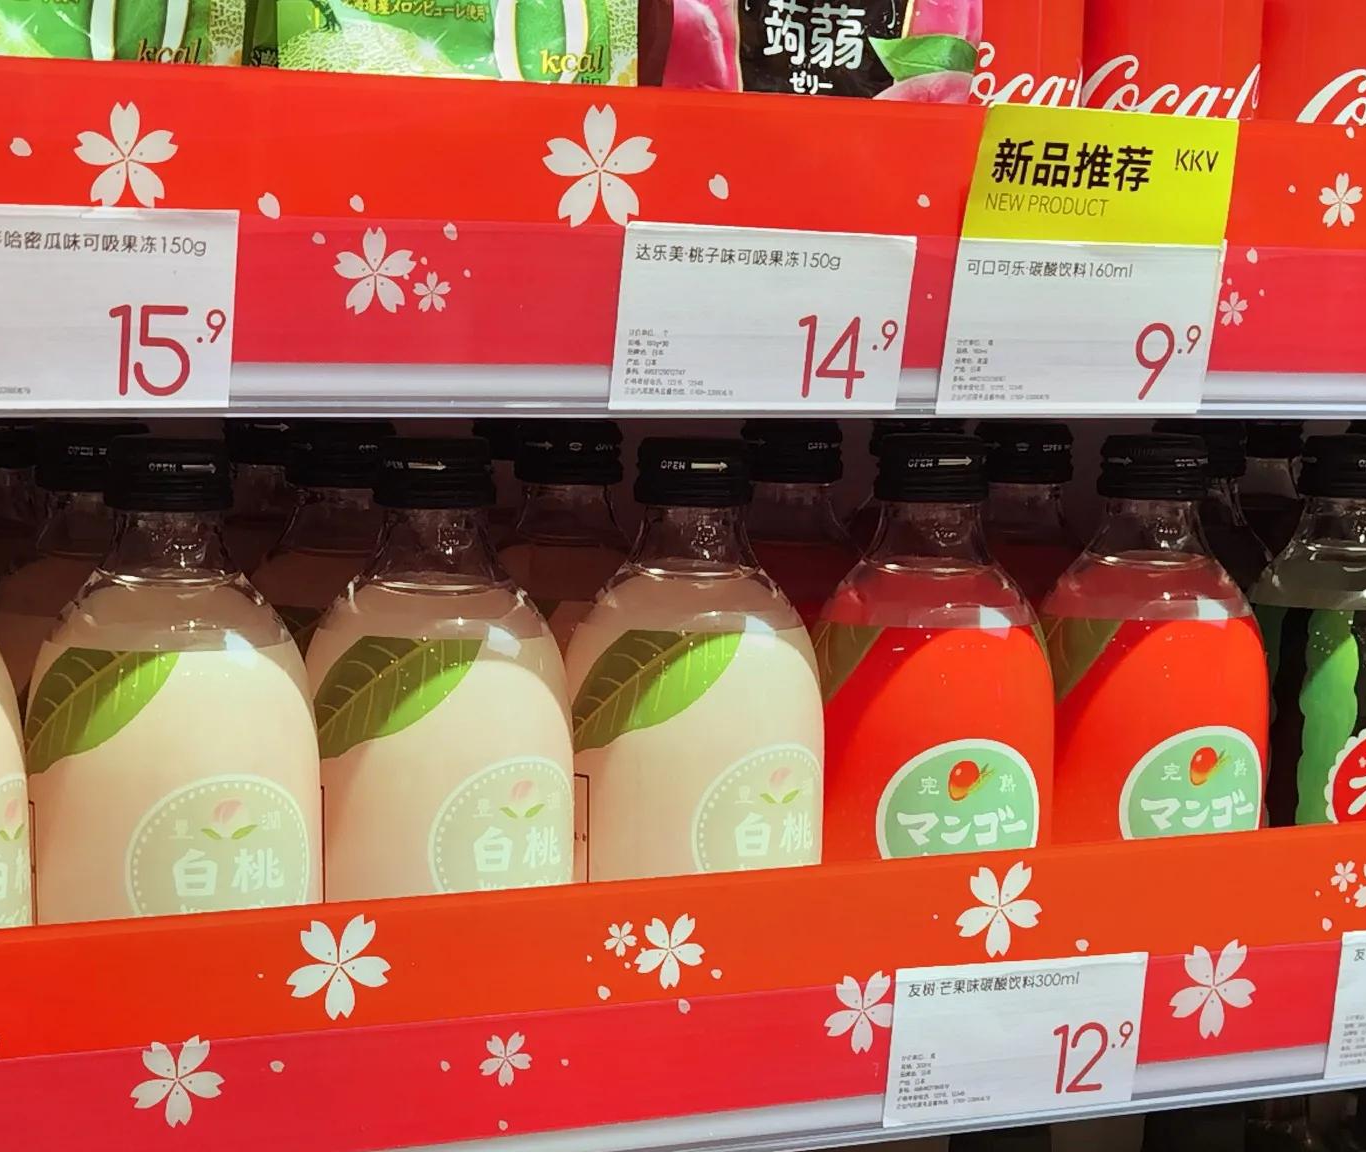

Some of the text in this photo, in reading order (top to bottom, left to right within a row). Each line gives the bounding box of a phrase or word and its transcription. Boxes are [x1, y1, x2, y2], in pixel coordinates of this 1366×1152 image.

[540, 44, 605, 75] kcal
[788, 71, 834, 95] ゼリー
[991, 138, 1154, 192] 新品推荐
[1174, 148, 1219, 174] KKV
[985, 192, 1109, 219] NEW PRODUCT
[108, 304, 227, 397] 15.9
[798, 314, 899, 400] 14.9
[1135, 322, 1202, 400] 9.9
[734, 810, 814, 858] 白桃
[897, 809, 1028, 846] マンゴー
[1140, 797, 1255, 833] マンゴー
[172, 848, 283, 899] 白桃
[472, 827, 562, 876] 白桃
[1053, 1020, 1134, 1095] 12.9
